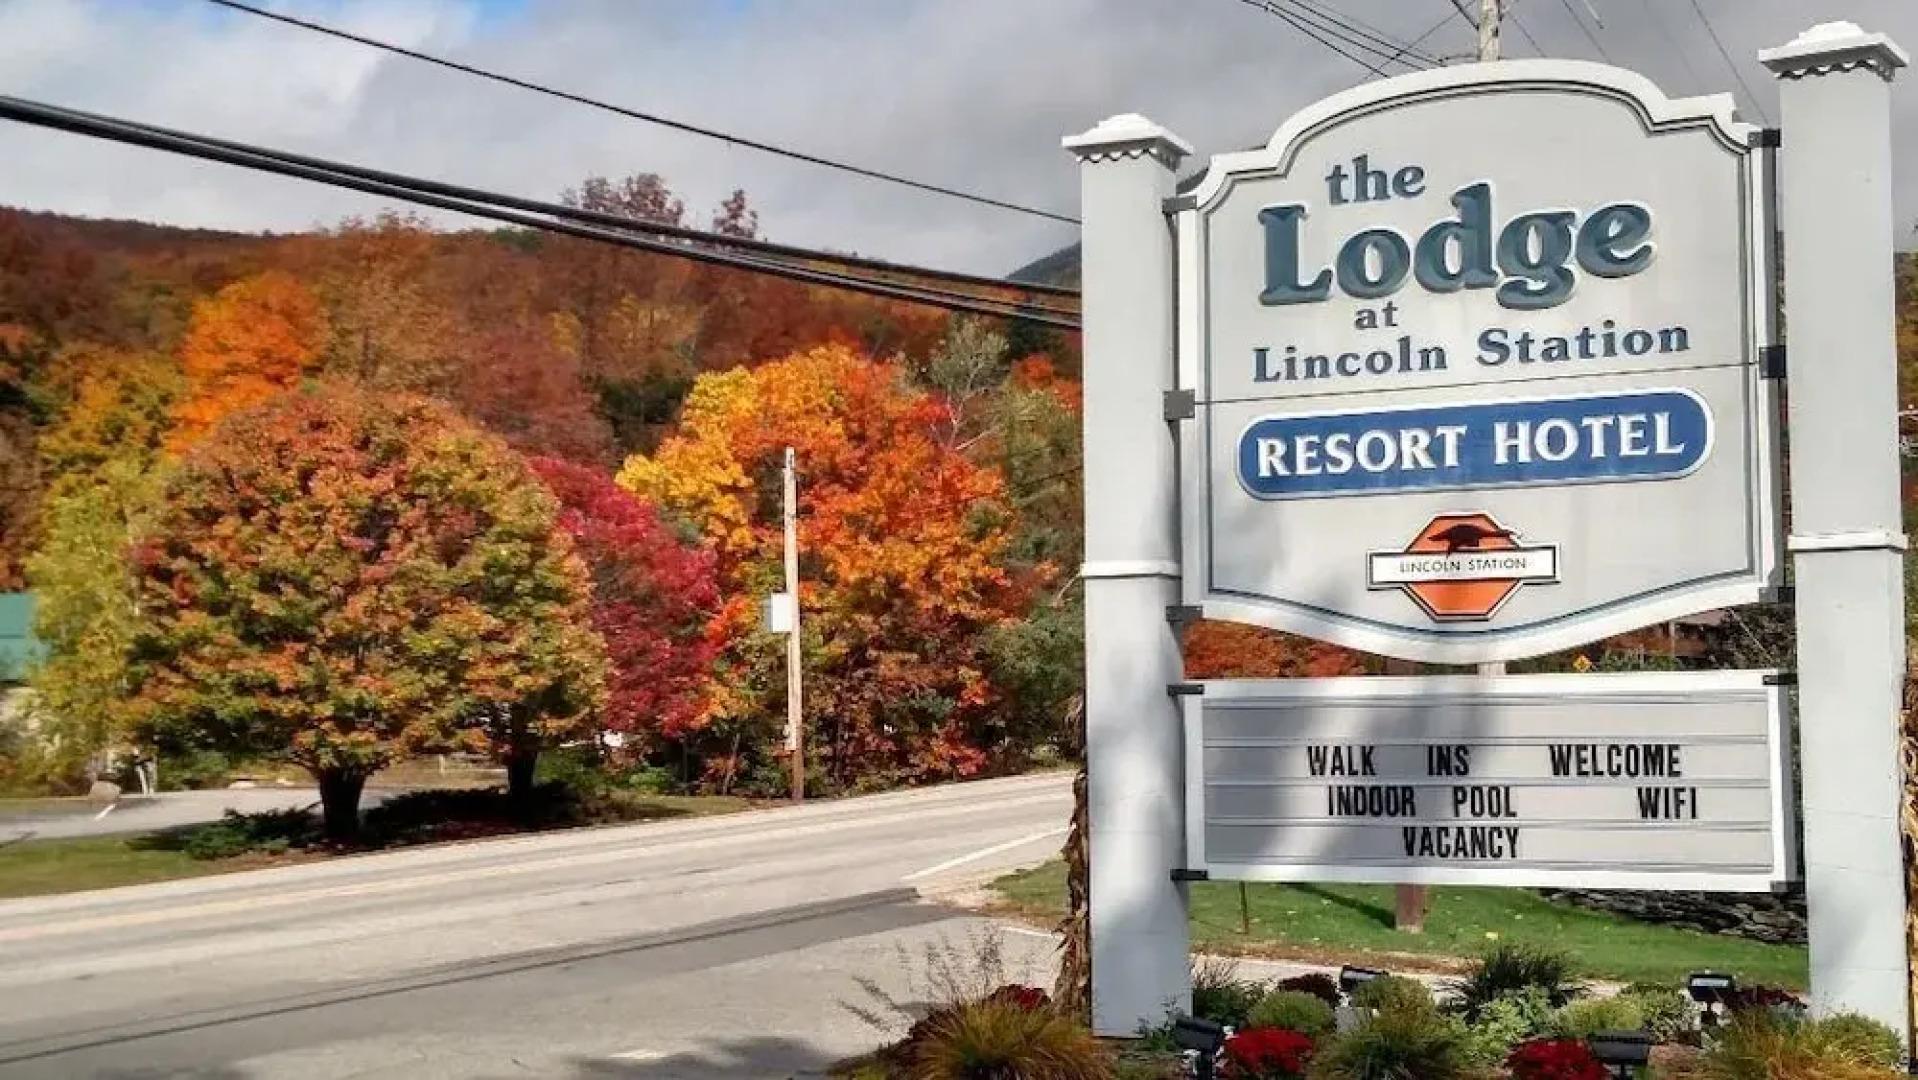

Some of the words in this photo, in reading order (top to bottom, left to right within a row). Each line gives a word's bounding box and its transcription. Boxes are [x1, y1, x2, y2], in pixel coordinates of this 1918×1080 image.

[1326, 154, 1425, 205] the
[1257, 181, 1654, 311] Lodge
[1354, 301, 1399, 329] at
[1253, 337, 1448, 383] Lincoln
[1475, 320, 1690, 366] Station
[1257, 425, 1468, 477] RESORT
[1494, 412, 1685, 465] HOTEL
[1400, 560, 1461, 573] LINCOLN
[1468, 558, 1526, 571] STATION
[1307, 745, 1376, 776] WALK
[1427, 745, 1470, 776] INS
[1549, 744, 1682, 776] WELCOME
[1328, 786, 1416, 817] INDOOR
[1453, 786, 1517, 817] POOL
[1637, 786, 1698, 819] WIFI
[1402, 826, 1520, 859] VACANCY
